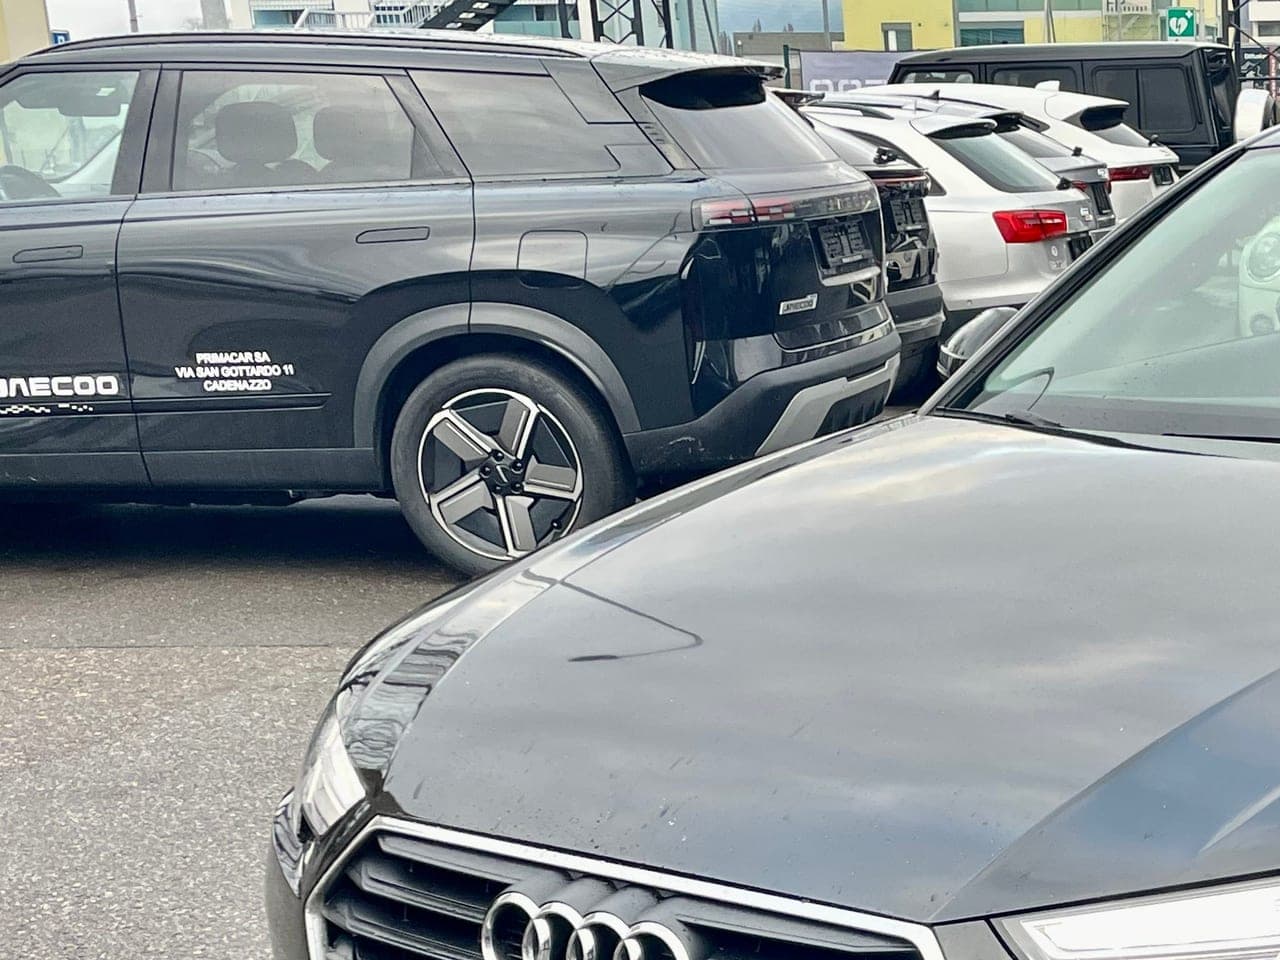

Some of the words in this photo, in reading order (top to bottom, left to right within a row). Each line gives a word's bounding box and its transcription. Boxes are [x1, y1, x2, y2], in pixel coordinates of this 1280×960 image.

[196, 352, 254, 364] PRIMACAR
[254, 351, 271, 363] SA
[175, 366, 196, 378] VIA
[196, 365, 220, 378] SAN
[221, 364, 282, 378] GOTTARDO
[282, 364, 295, 376] 11
[203, 379, 272, 392] CADENAZZO
